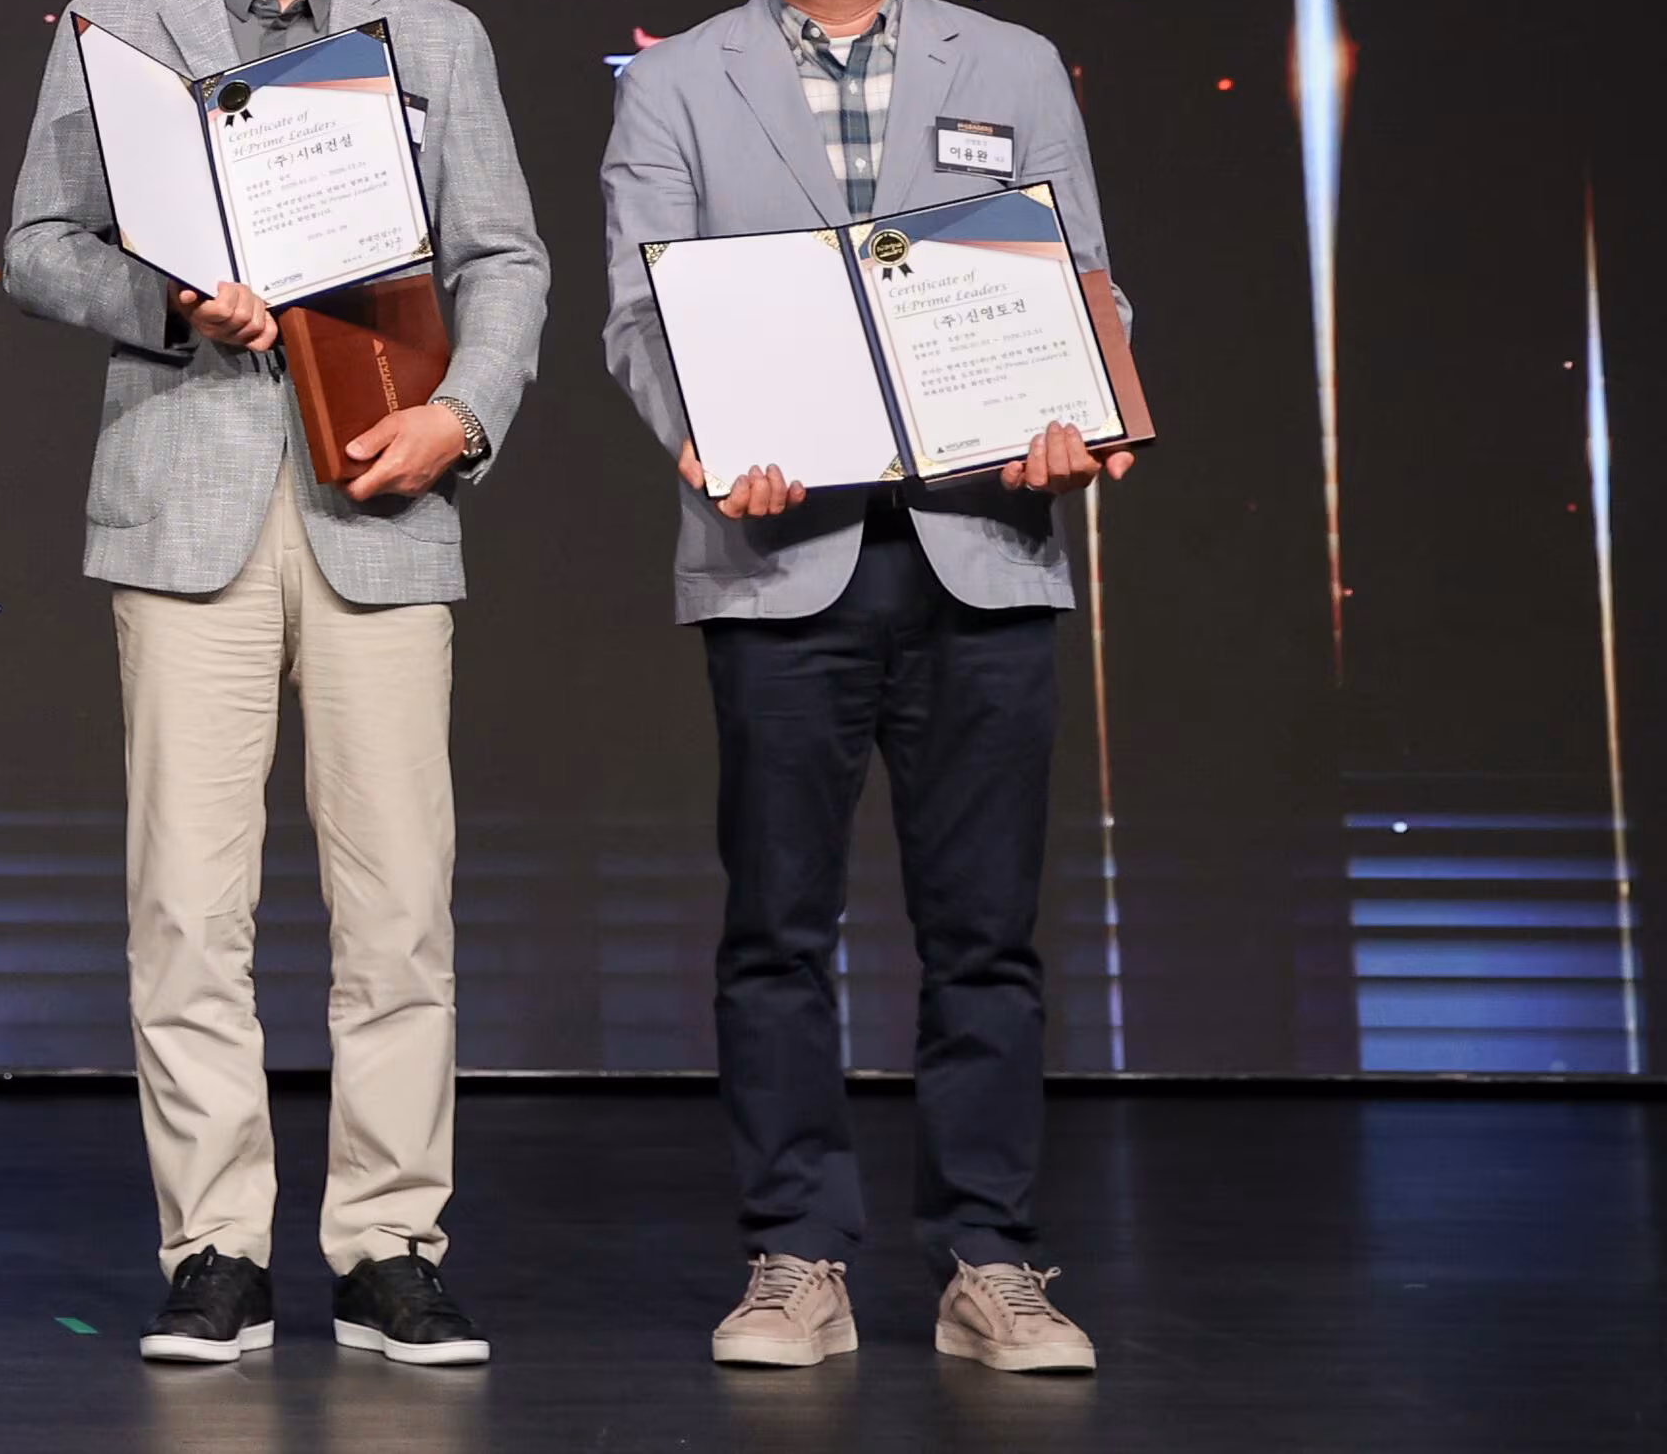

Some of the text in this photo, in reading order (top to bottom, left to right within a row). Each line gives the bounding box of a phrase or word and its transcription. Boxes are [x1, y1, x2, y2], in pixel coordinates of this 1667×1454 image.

[888, 275, 960, 299] Certificate
[955, 281, 1009, 301] Leaders
[933, 298, 1028, 330] (주)신영토건
